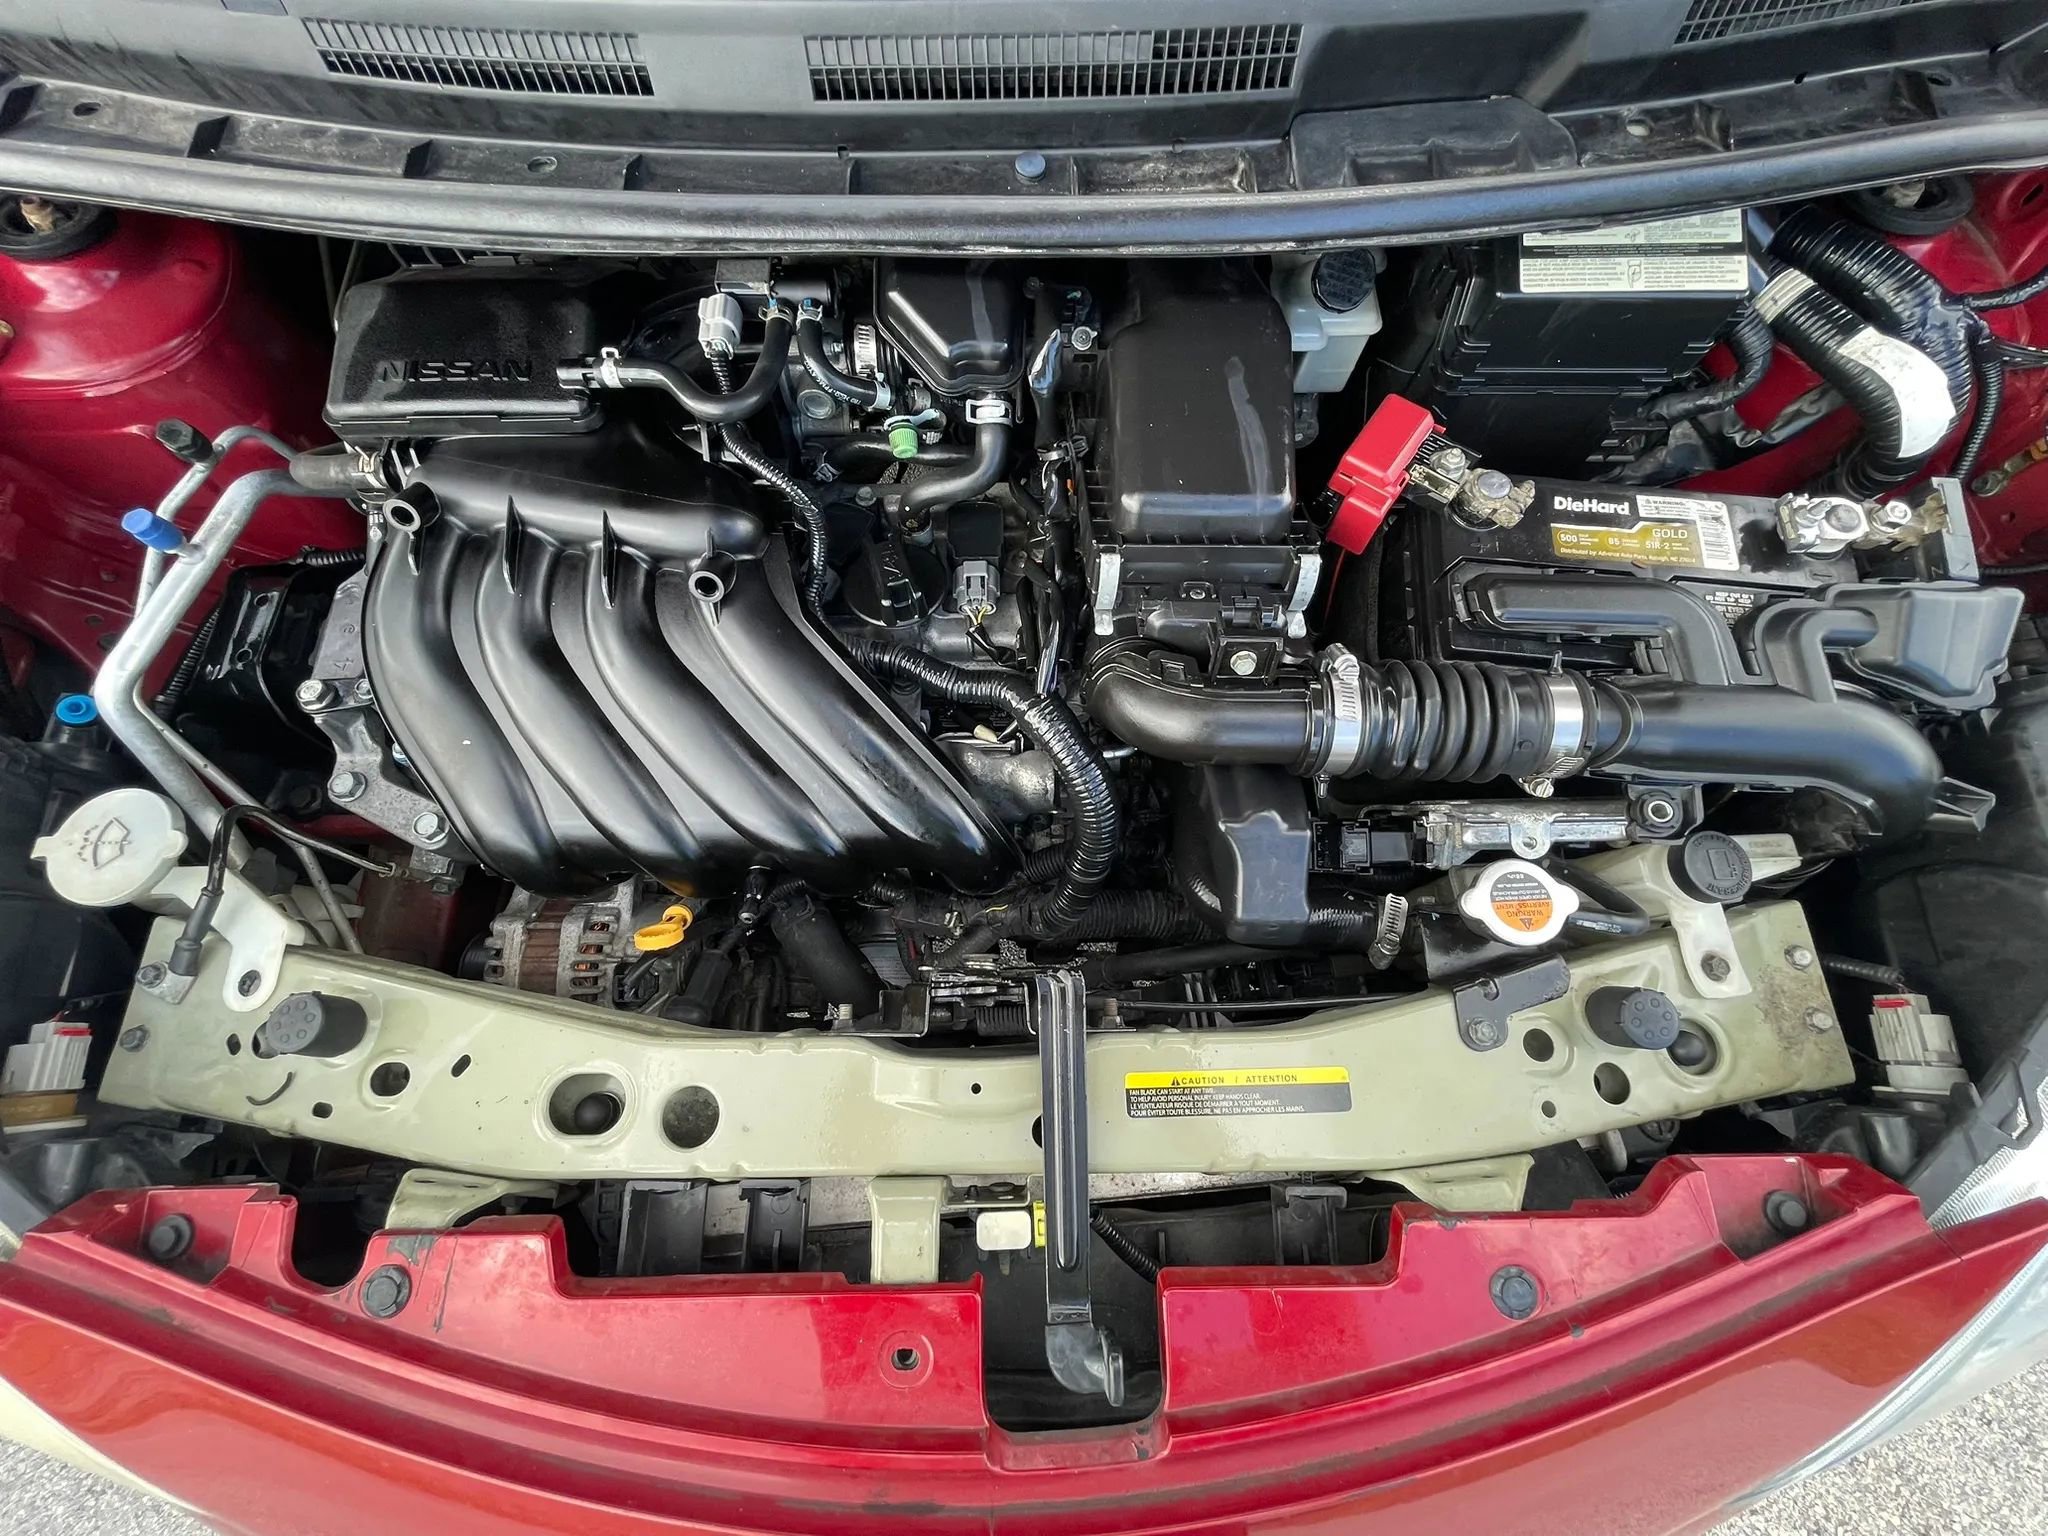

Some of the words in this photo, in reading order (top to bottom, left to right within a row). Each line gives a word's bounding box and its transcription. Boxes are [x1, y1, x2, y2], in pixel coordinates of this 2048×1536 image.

[376, 360, 532, 382] NISSAN
[1553, 496, 1631, 516] DieHard
[1560, 533, 1577, 543] 500
[1652, 528, 1688, 539] GOLD
[1560, 547, 1588, 555] Distributed
[1506, 909, 1544, 918] WARNING
[1181, 1076, 1224, 1085] CAUTION
[1245, 1074, 1298, 1083] ATTENTION
